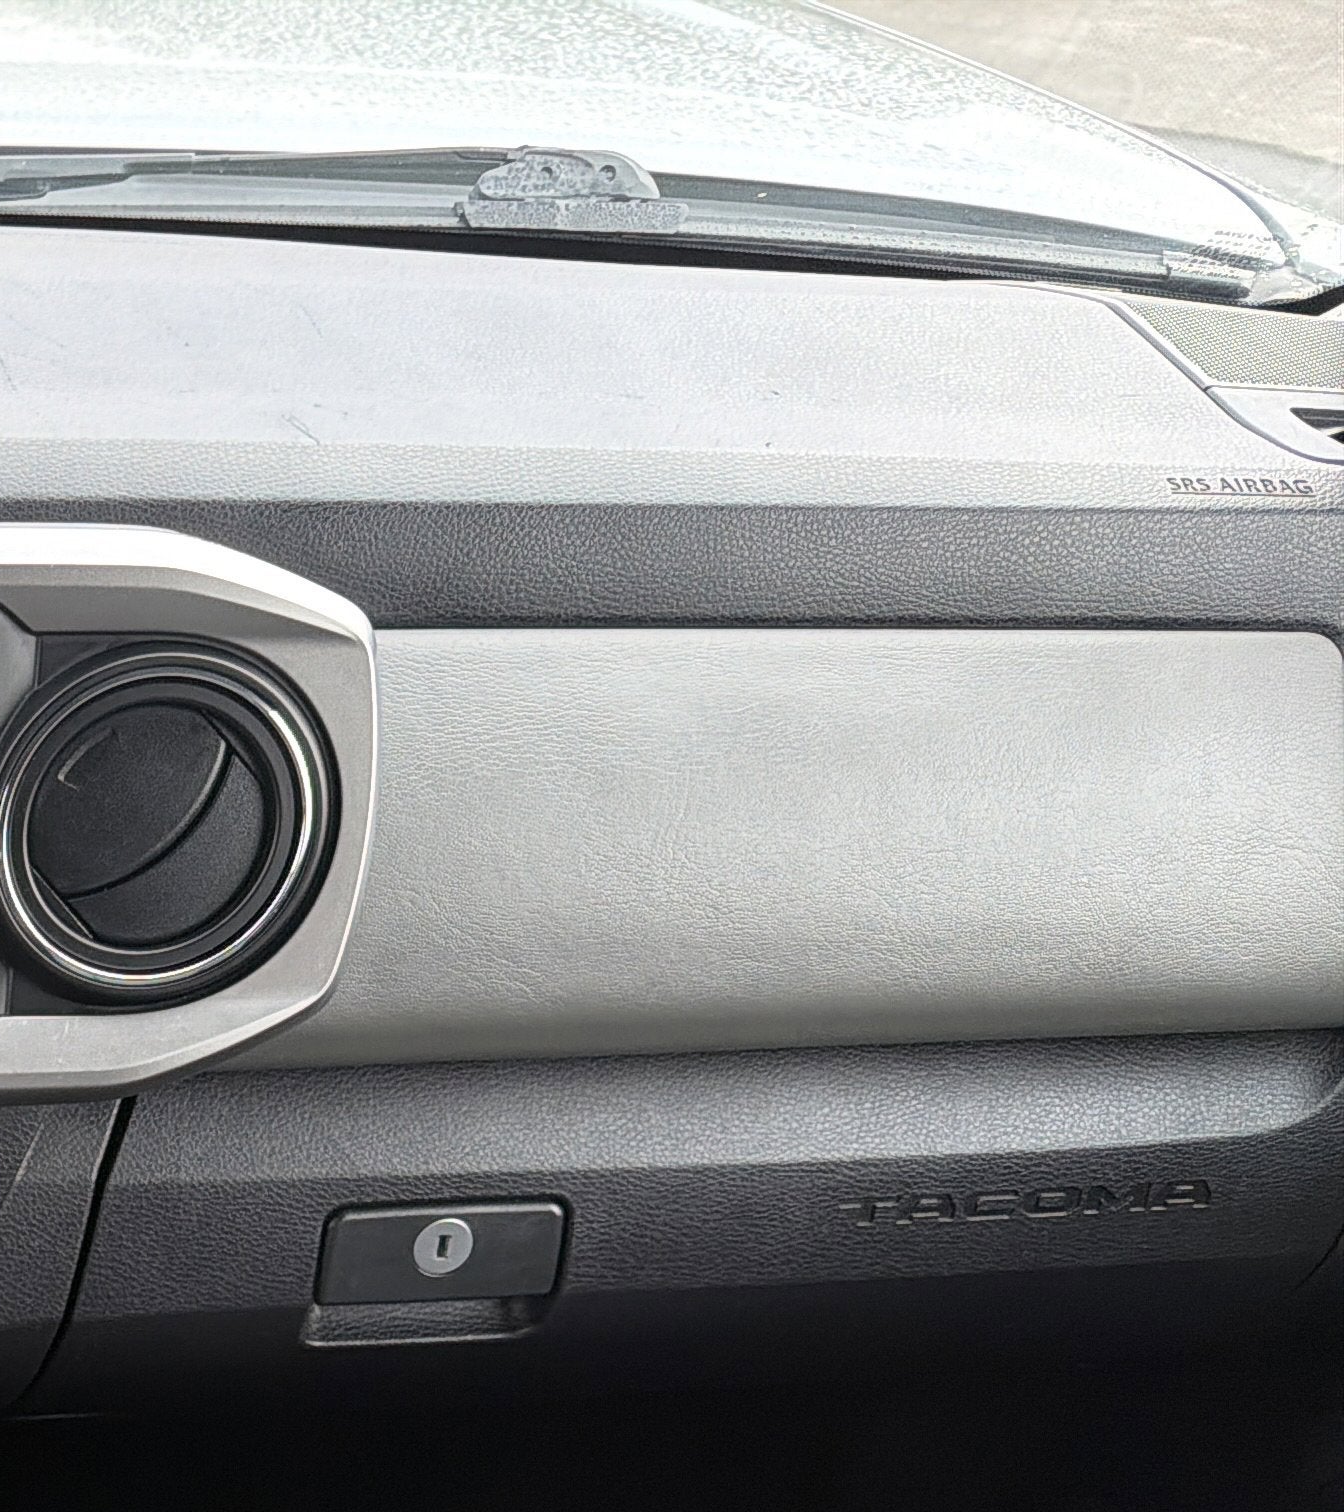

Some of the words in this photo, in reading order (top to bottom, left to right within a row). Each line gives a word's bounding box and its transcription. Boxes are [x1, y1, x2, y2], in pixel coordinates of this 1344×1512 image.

[1166, 478, 1211, 492] SRS
[1219, 477, 1315, 495] AIRBAG
[839, 1179, 1212, 1227] TACOMA
